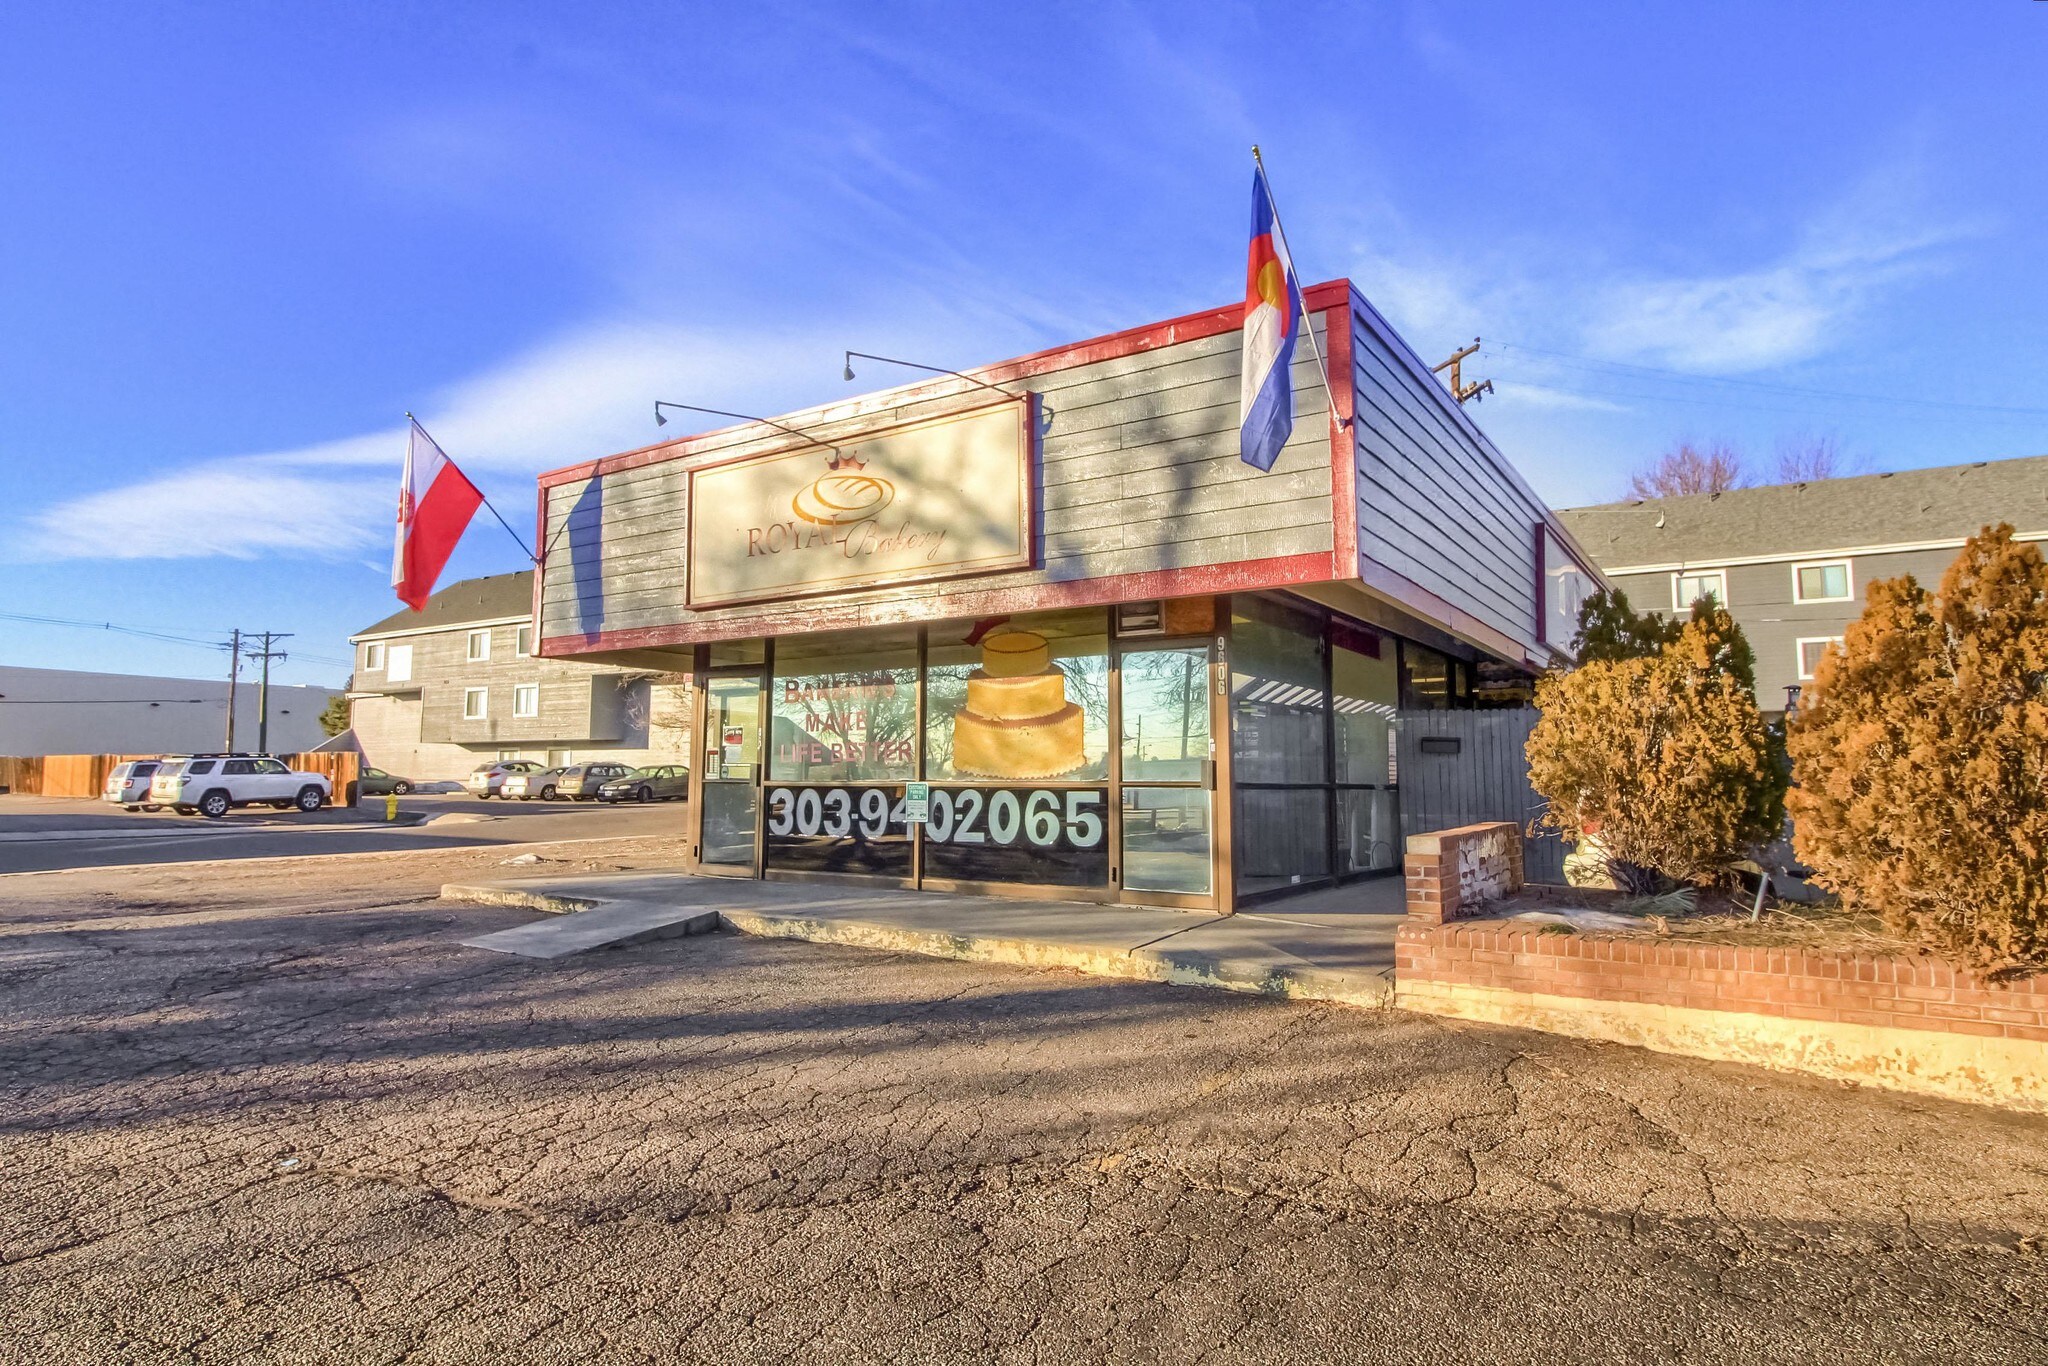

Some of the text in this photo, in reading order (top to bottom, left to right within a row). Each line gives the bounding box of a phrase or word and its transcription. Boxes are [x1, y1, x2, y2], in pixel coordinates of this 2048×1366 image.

[747, 513, 947, 561] ROYAL Bakery
[805, 711, 868, 733] MAKE
[780, 741, 912, 763] LIFE BETTER
